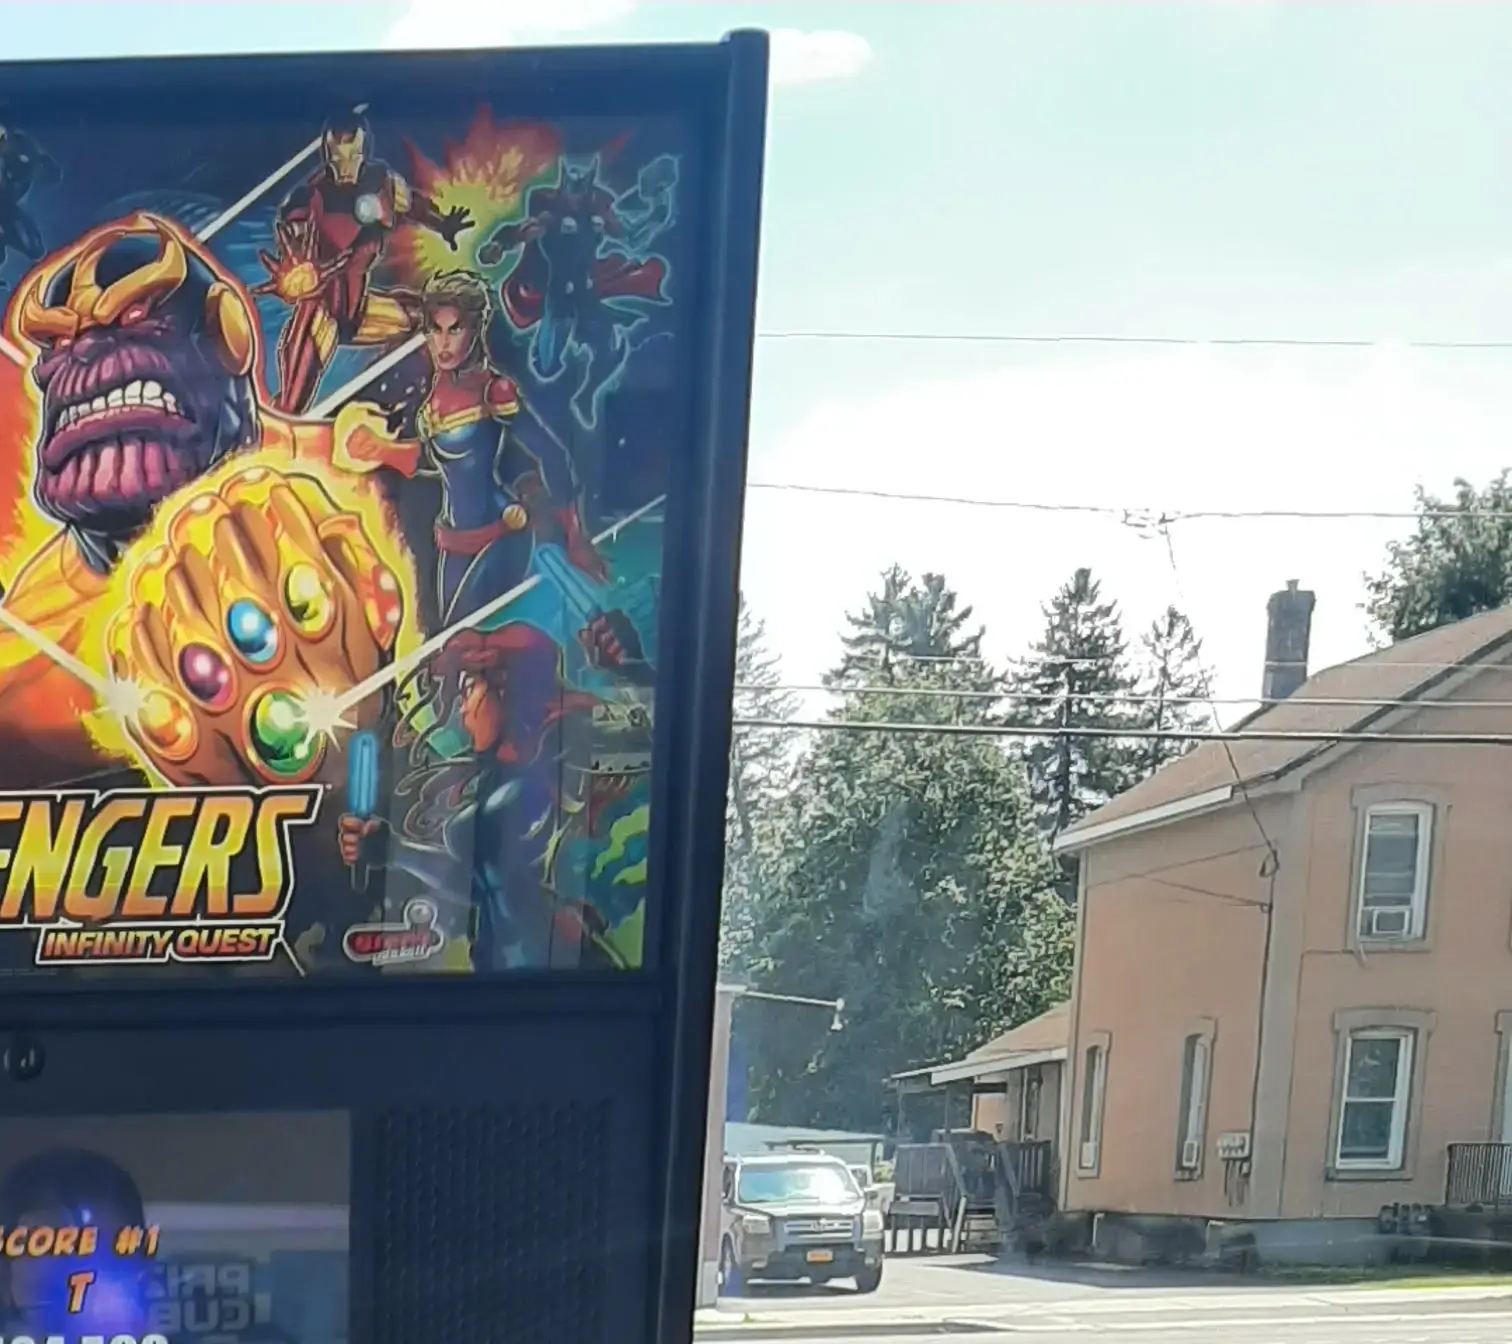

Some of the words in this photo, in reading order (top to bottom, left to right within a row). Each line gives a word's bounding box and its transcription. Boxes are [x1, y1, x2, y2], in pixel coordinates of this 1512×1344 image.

[44, 928, 169, 959] INFINITY
[170, 927, 276, 958] QUEST
[114, 1223, 161, 1257] #1
[66, 1269, 97, 1315] T
